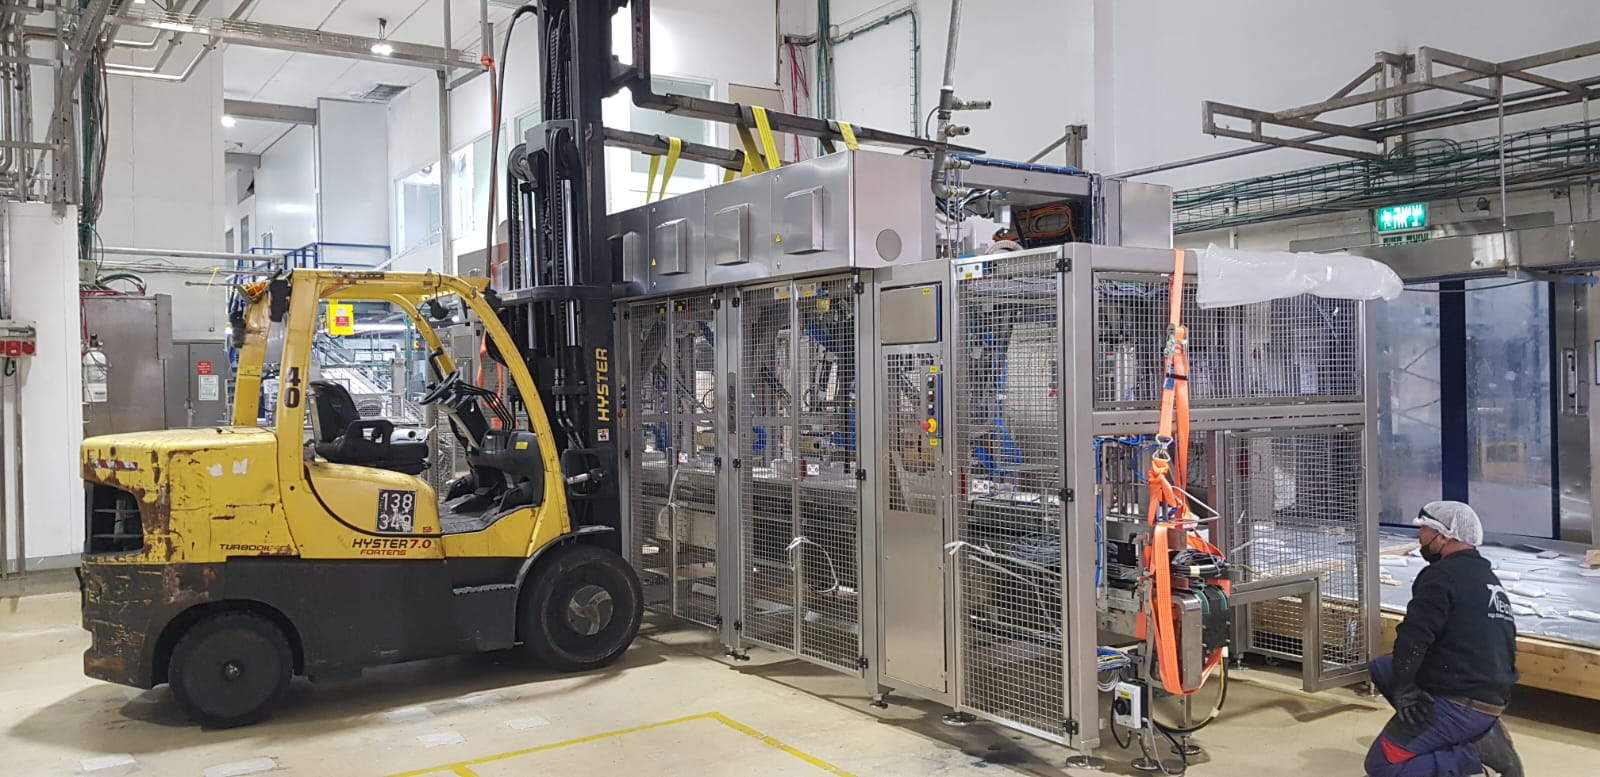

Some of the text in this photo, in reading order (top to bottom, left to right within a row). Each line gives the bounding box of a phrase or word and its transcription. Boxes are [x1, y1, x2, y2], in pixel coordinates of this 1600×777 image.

[284, 366, 301, 408] 40
[595, 347, 610, 421] HYSTER
[381, 492, 413, 511] 138
[352, 538, 432, 549] HYSTER 7.0
